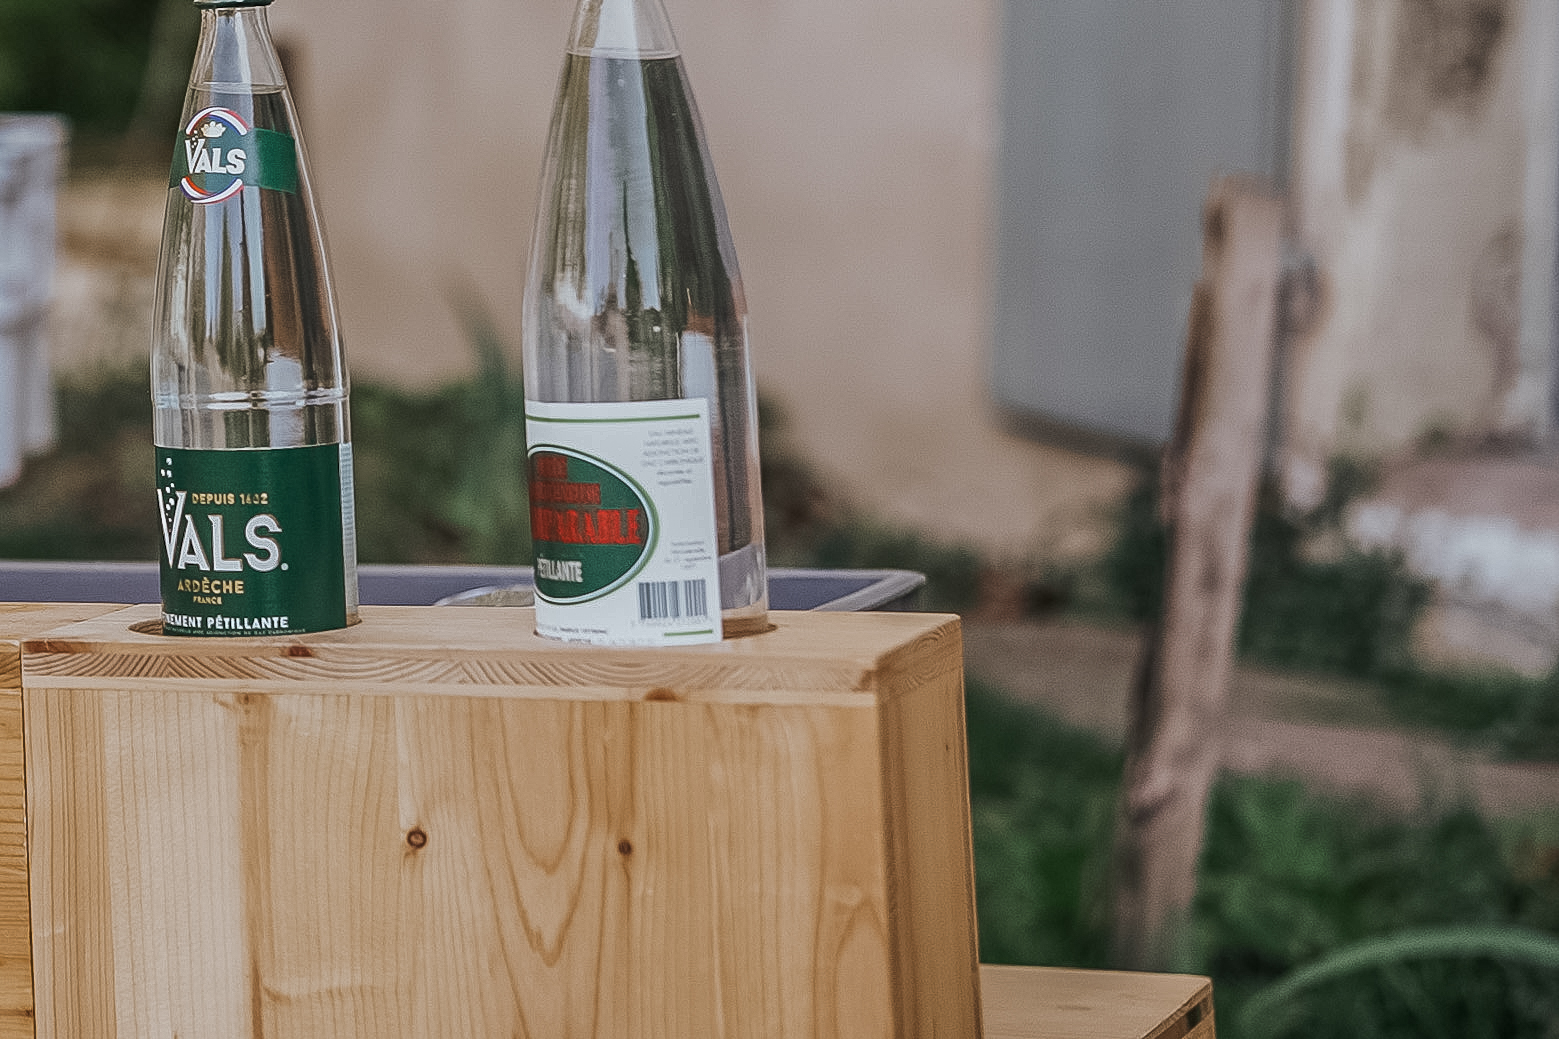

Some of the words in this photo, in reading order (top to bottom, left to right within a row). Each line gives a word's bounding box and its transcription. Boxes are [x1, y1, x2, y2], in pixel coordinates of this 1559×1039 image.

[185, 138, 247, 175] VALS
[191, 492, 236, 505] DEPUIS
[177, 576, 245, 595] ARDÈCHE
[193, 595, 223, 606] FRANCE
[206, 614, 290, 631] PÉTILLANTE
